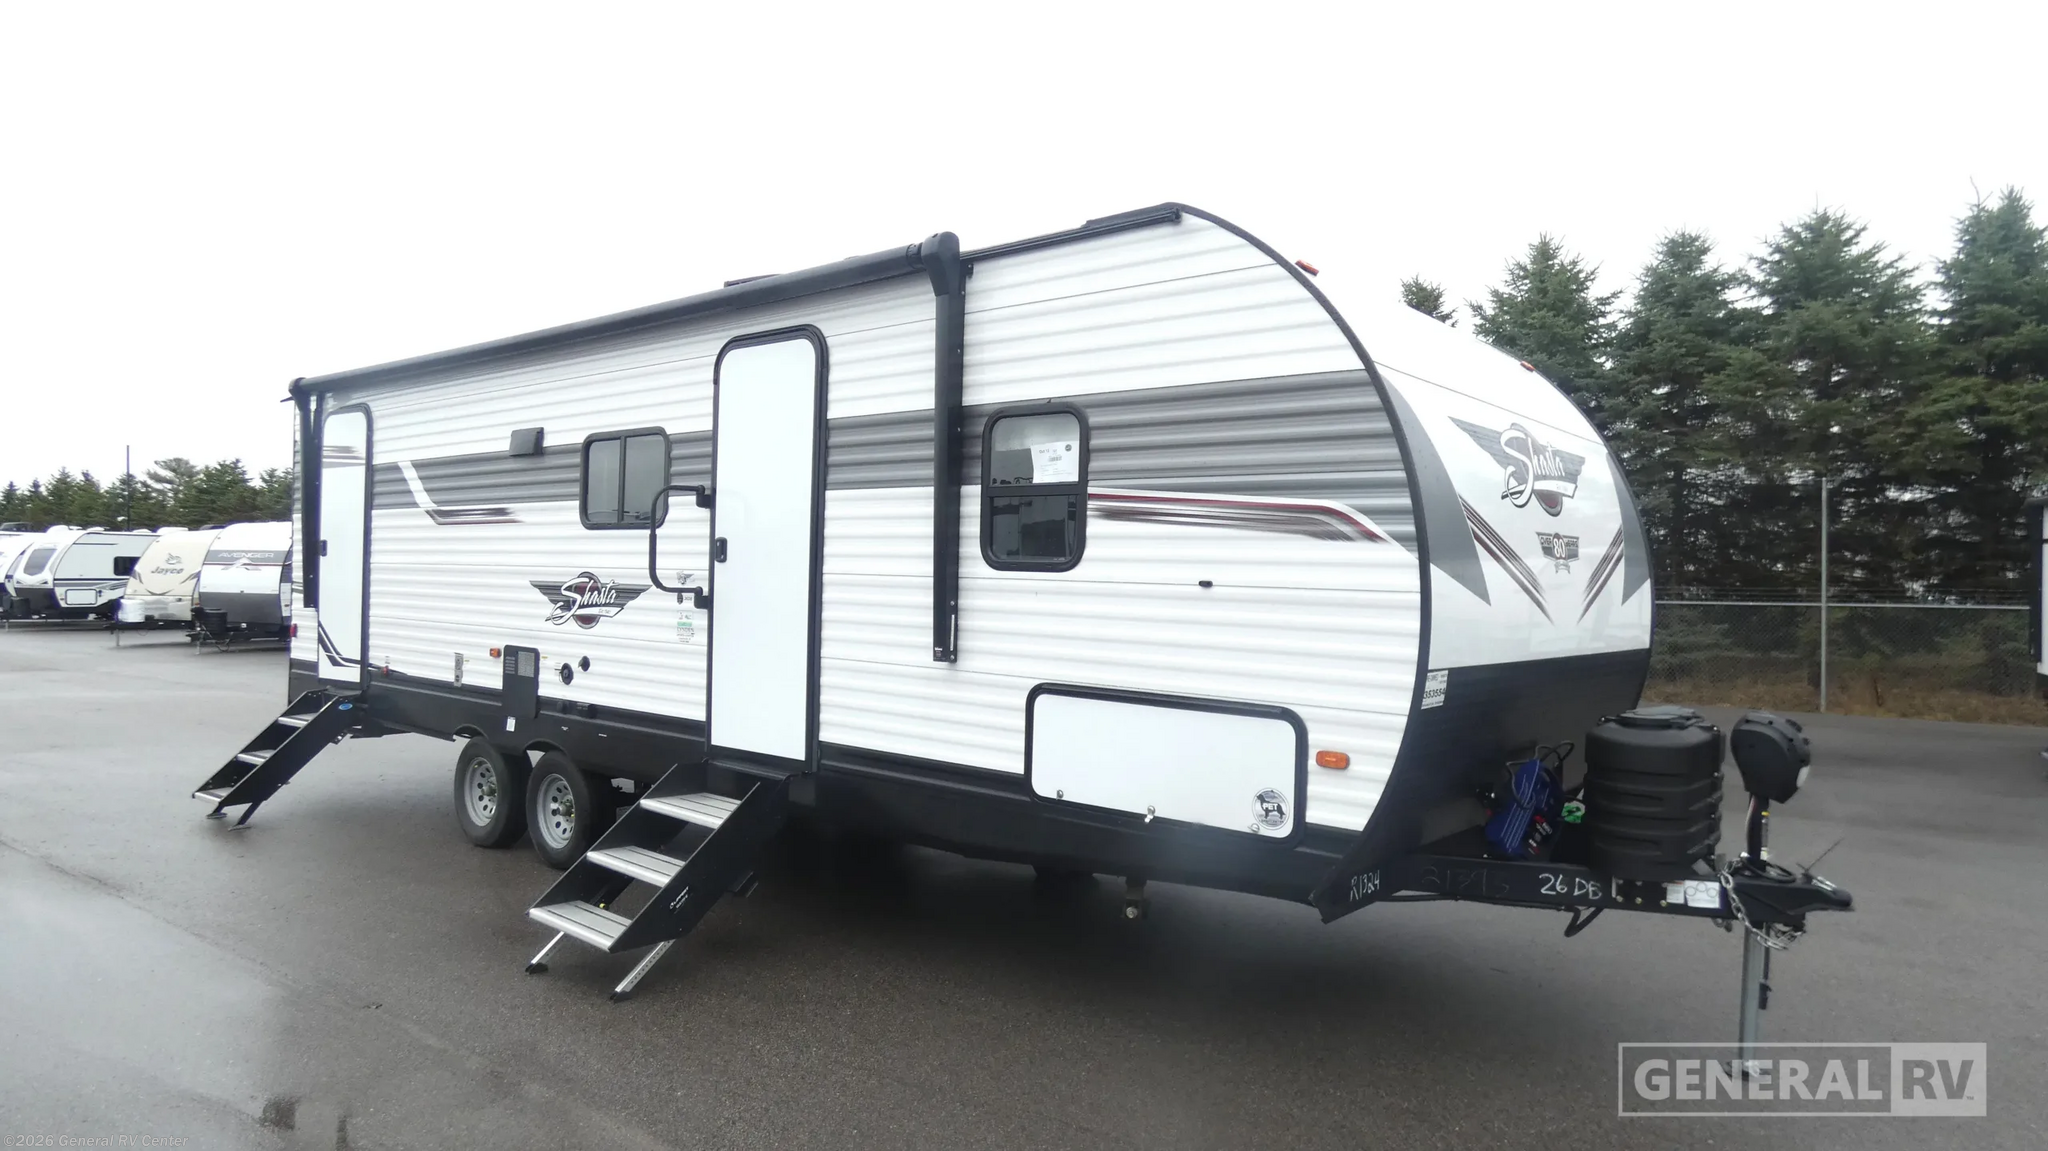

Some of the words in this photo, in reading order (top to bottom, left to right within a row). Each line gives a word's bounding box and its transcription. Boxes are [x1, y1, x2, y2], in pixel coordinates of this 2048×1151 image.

[1500, 428, 1566, 508] Shasta
[1553, 537, 1567, 558] 80
[151, 566, 184, 575] Jayco
[548, 577, 620, 625] Shasta
[1263, 803, 1278, 811] PET
[1539, 873, 1568, 895] 26
